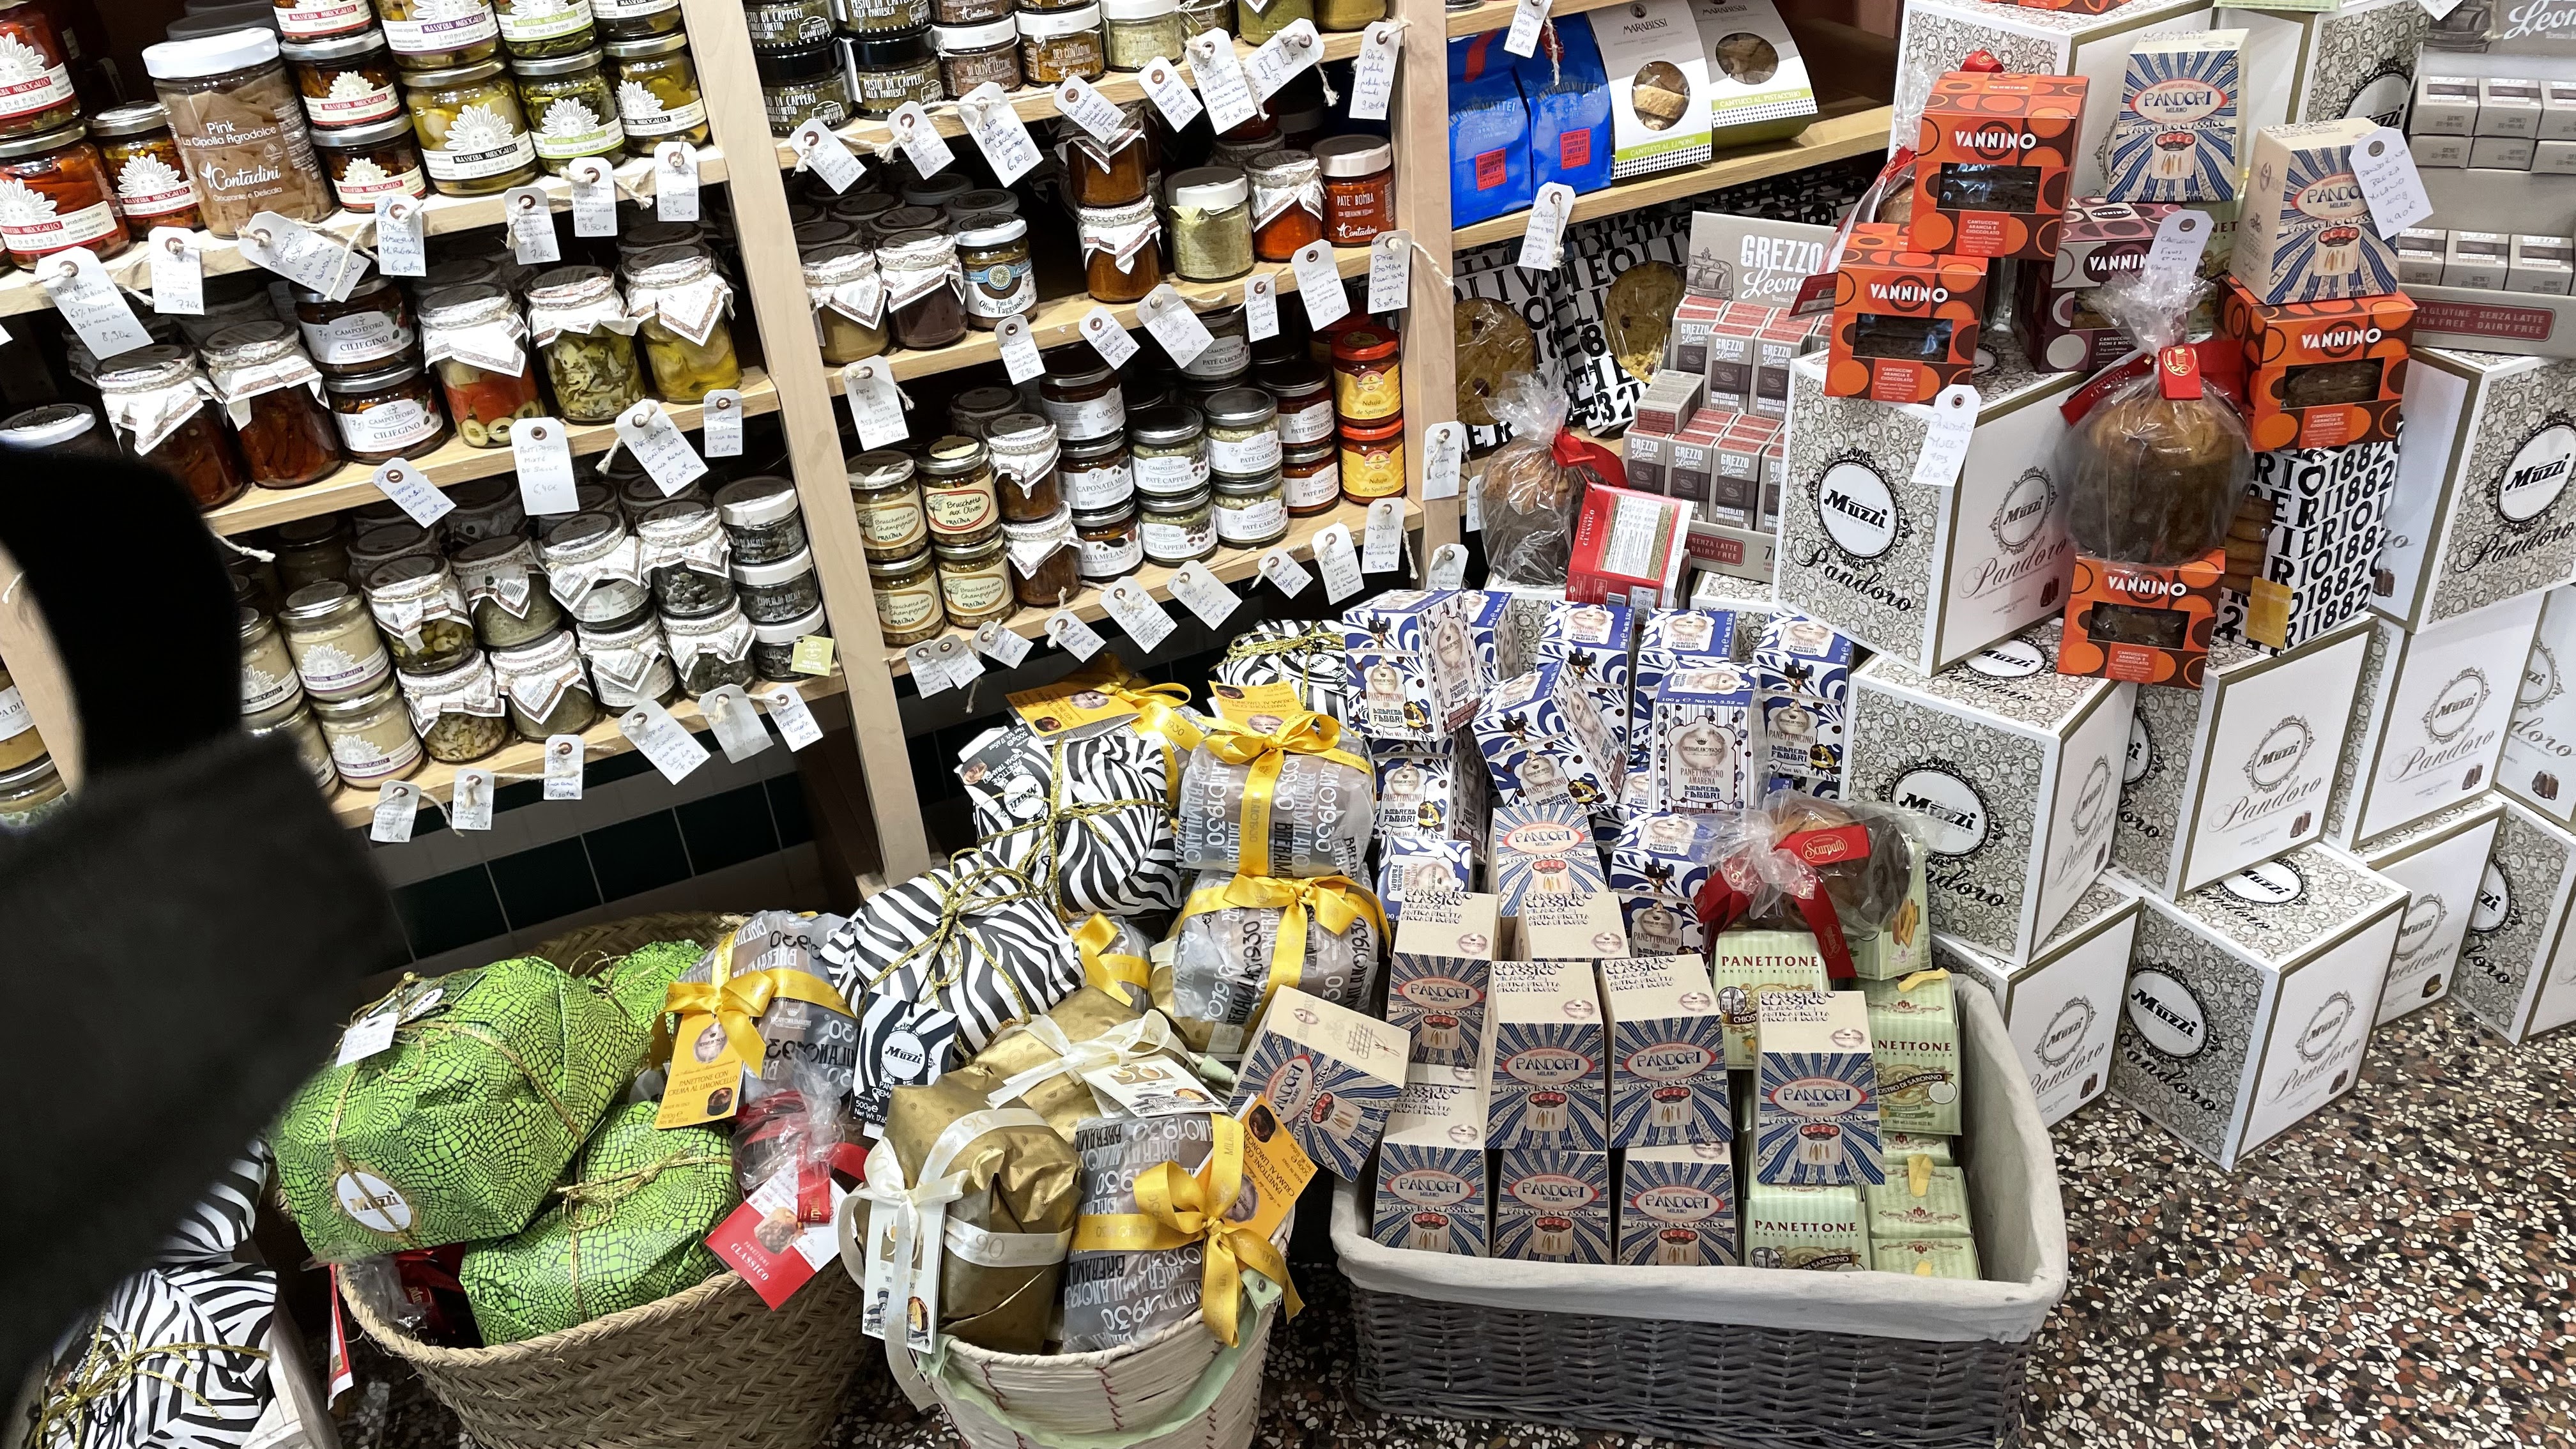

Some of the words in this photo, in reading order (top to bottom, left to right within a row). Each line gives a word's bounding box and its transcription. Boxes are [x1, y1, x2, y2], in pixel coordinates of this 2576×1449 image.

[771, 8, 803, 22] CAPPERI
[853, 8, 866, 17] ALLA
[868, 6, 895, 17] PANTESCA
[1702, 4, 1747, 15] MARABISSI
[1623, 18, 1668, 34] MARABISSI
[864, 80, 883, 90] PESTO
[886, 79, 894, 88] DI
[898, 73, 924, 88] CAPPERI
[786, 93, 816, 106] CAPPERI
[880, 88, 906, 98] PANTESCA
[1720, 97, 1752, 108] CANTUCCI
[1764, 90, 1801, 102] PISTACCHIO
[2144, 91, 2211, 107] PANDORI
[206, 121, 236, 134] Pink
[2180, 120, 2226, 130] CLASSICO
[181, 137, 192, 146] La
[192, 134, 224, 147] Cipolla
[227, 126, 276, 144] Agrodolce
[1955, 130, 2037, 150] VANNINO
[1630, 143, 1662, 157] CANTUCCI
[1662, 141, 1671, 150] AL
[1355, 193, 1374, 205] BOMBA
[1740, 234, 1824, 275] GREZZO
[1870, 283, 1949, 303] VANNINO
[979, 299, 995, 314] Olive
[997, 293, 1027, 314] Taggiasche
[2439, 319, 2465, 328] FREE
[2513, 314, 2545, 324] LATTE
[335, 326, 362, 337] CAMPO
[363, 321, 384, 334] D'ORO
[1680, 323, 1709, 335] GREZZO
[340, 335, 389, 351] CILIEGINO
[1716, 338, 1744, 352] GREZZO
[2301, 328, 2382, 350] VANNINO
[1364, 406, 1388, 415] Spilinga
[368, 415, 395, 426] CAMPO
[373, 422, 420, 440] CILIEGINO
[1631, 438, 1659, 452] GREZZO
[1675, 446, 1703, 461] GREZZO
[1721, 454, 1750, 469] GREZZO
[1163, 474, 1192, 484] CAPPERI
[2504, 453, 2570, 491] Muzzi
[1369, 477, 1388, 486] Nduja
[1370, 484, 1393, 493] Spilinga
[946, 496, 981, 510] Bruschetta
[1823, 488, 1888, 530] Muzzi
[2002, 494, 2044, 526] Muzzi
[1583, 509, 1595, 546] CLASSICO
[1692, 537, 1715, 548] SENZA
[1716, 541, 1738, 551] LATTE
[2454, 522, 2575, 572] Pandoro
[1691, 544, 1714, 556] DAIRY
[1717, 551, 1737, 560] FREE
[1790, 535, 1916, 612] Pandoro
[1959, 535, 2067, 600] Pandoro
[960, 584, 991, 594] Bruschetta
[961, 585, 1002, 600] Champignons
[2108, 574, 2187, 597] VANNINO
[1368, 692, 1404, 702] PANETTONCINO
[2435, 693, 2477, 719] Muzzi
[1768, 730, 1814, 744] PANETTONCINO
[1771, 753, 1808, 763] FABBRI
[2256, 742, 2301, 767] Muzzi
[2384, 728, 2496, 784] Pandoro
[1680, 768, 1724, 778] PANETTONCINO
[1525, 777, 1567, 796] PANETTONCINO
[1689, 777, 1716, 785] AMARENA
[1383, 793, 1422, 802] PANETTONCINO
[2206, 775, 2323, 833] Pandoro
[1384, 815, 1416, 823] FABBRI
[1899, 791, 1977, 832] Muzzi
[1514, 831, 1571, 843] PANDORI
[1405, 896, 1462, 906] CLASSICO
[1721, 954, 1820, 967] PANETTONE
[1411, 985, 1469, 999] PANDORI
[1760, 991, 1836, 999] PANDORINO
[2132, 986, 2198, 1040] Muzzi
[2045, 1015, 2087, 1047] Muzzi
[2310, 1010, 2348, 1043] Muzzi
[885, 1045, 923, 1064] Muzzi
[1636, 1051, 1702, 1066] PANDORI
[1515, 1057, 1579, 1071] PANDORI
[679, 1073, 714, 1086] PANETTONE
[715, 1070, 728, 1080] CON
[1907, 1073, 1943, 1087] SARONNO
[2119, 1032, 2220, 1114] Pandoro
[2262, 1038, 2359, 1107] Pandoro
[668, 1087, 690, 1096] CREMA
[699, 1075, 738, 1090] LIMONCELLO
[1783, 1089, 1851, 1101] PANDORI
[1399, 1176, 1462, 1195] PANDORI
[1521, 1182, 1585, 1198] PANDORI
[1754, 1219, 1859, 1233] PANETTONE
[974, 1229, 1007, 1258] 90
[730, 1243, 769, 1281] CLASSICO
[1811, 1255, 1850, 1268] SARONNO
